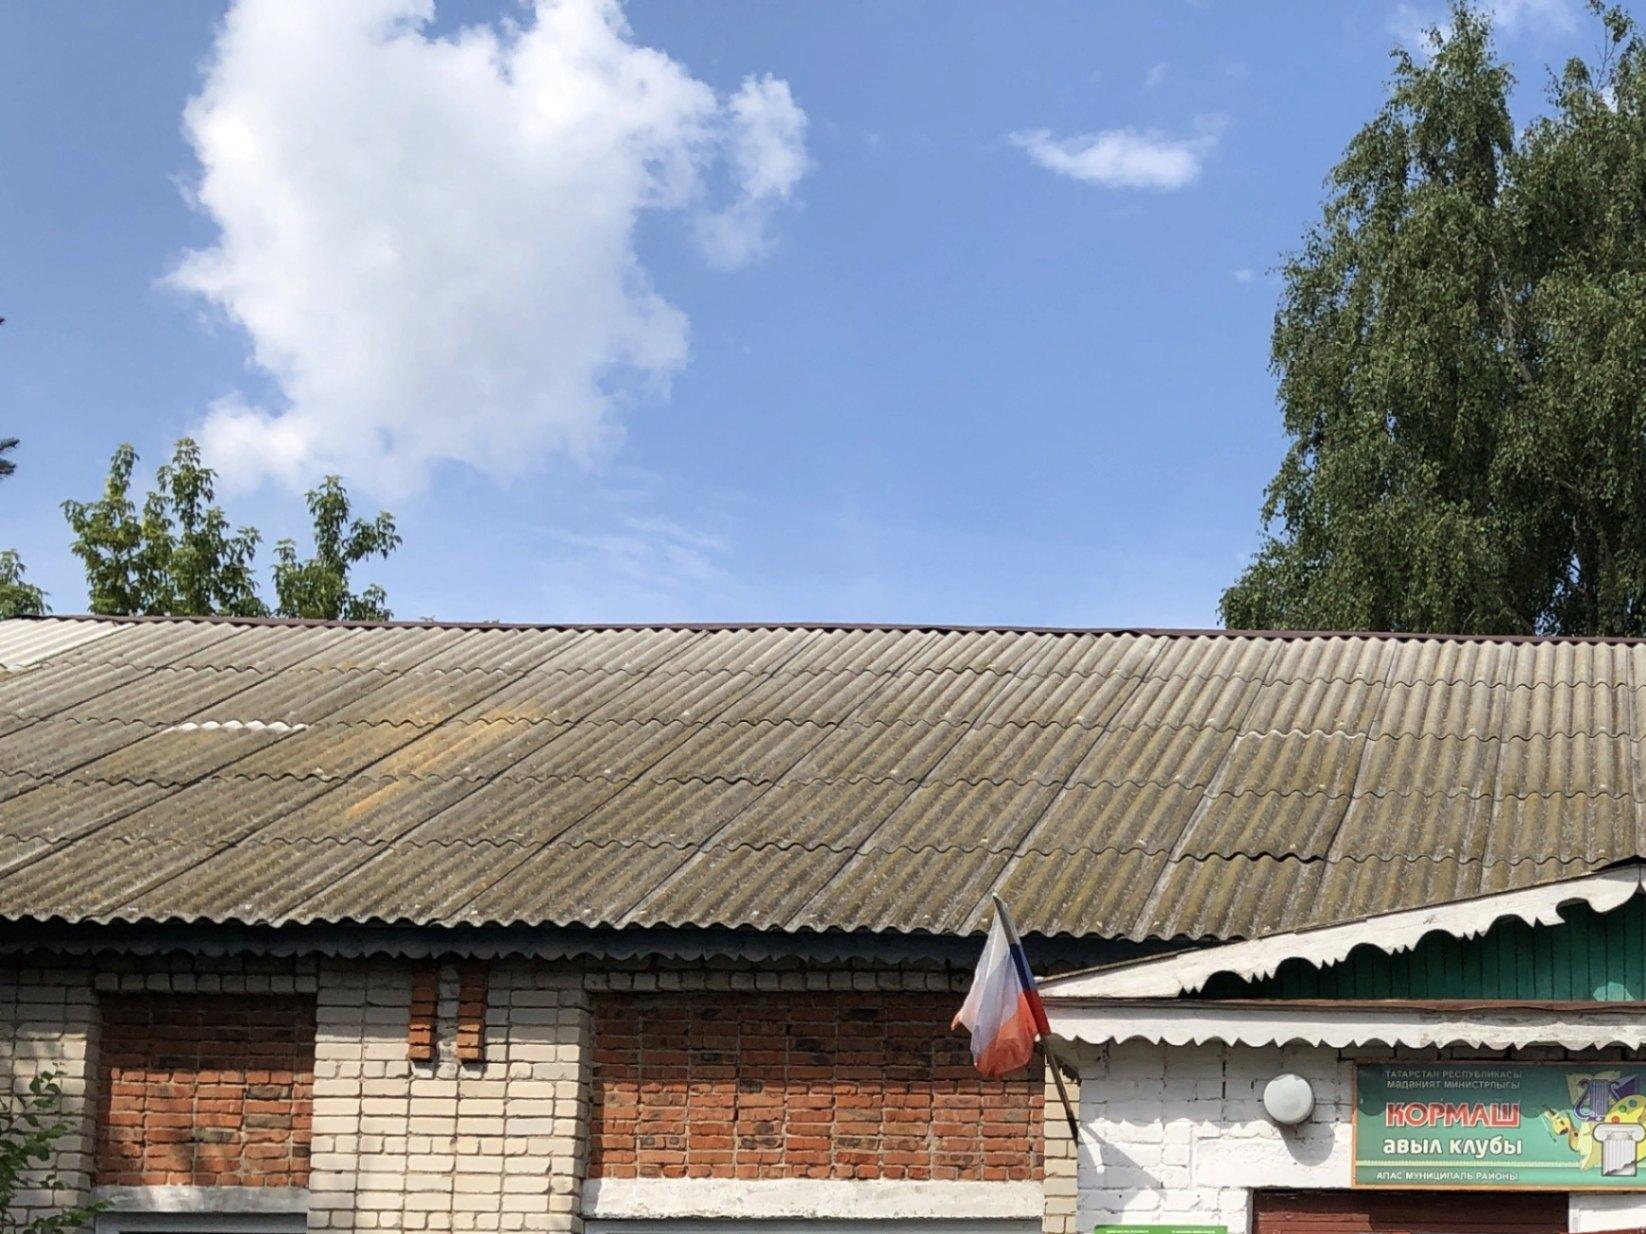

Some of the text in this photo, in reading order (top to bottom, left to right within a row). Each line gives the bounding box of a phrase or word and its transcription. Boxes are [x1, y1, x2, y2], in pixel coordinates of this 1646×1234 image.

[1385, 1101, 1521, 1128] КОРМАШ
[1383, 1136, 1522, 1159] авыл клубы
[1376, 1171, 1403, 1180] АПАС
